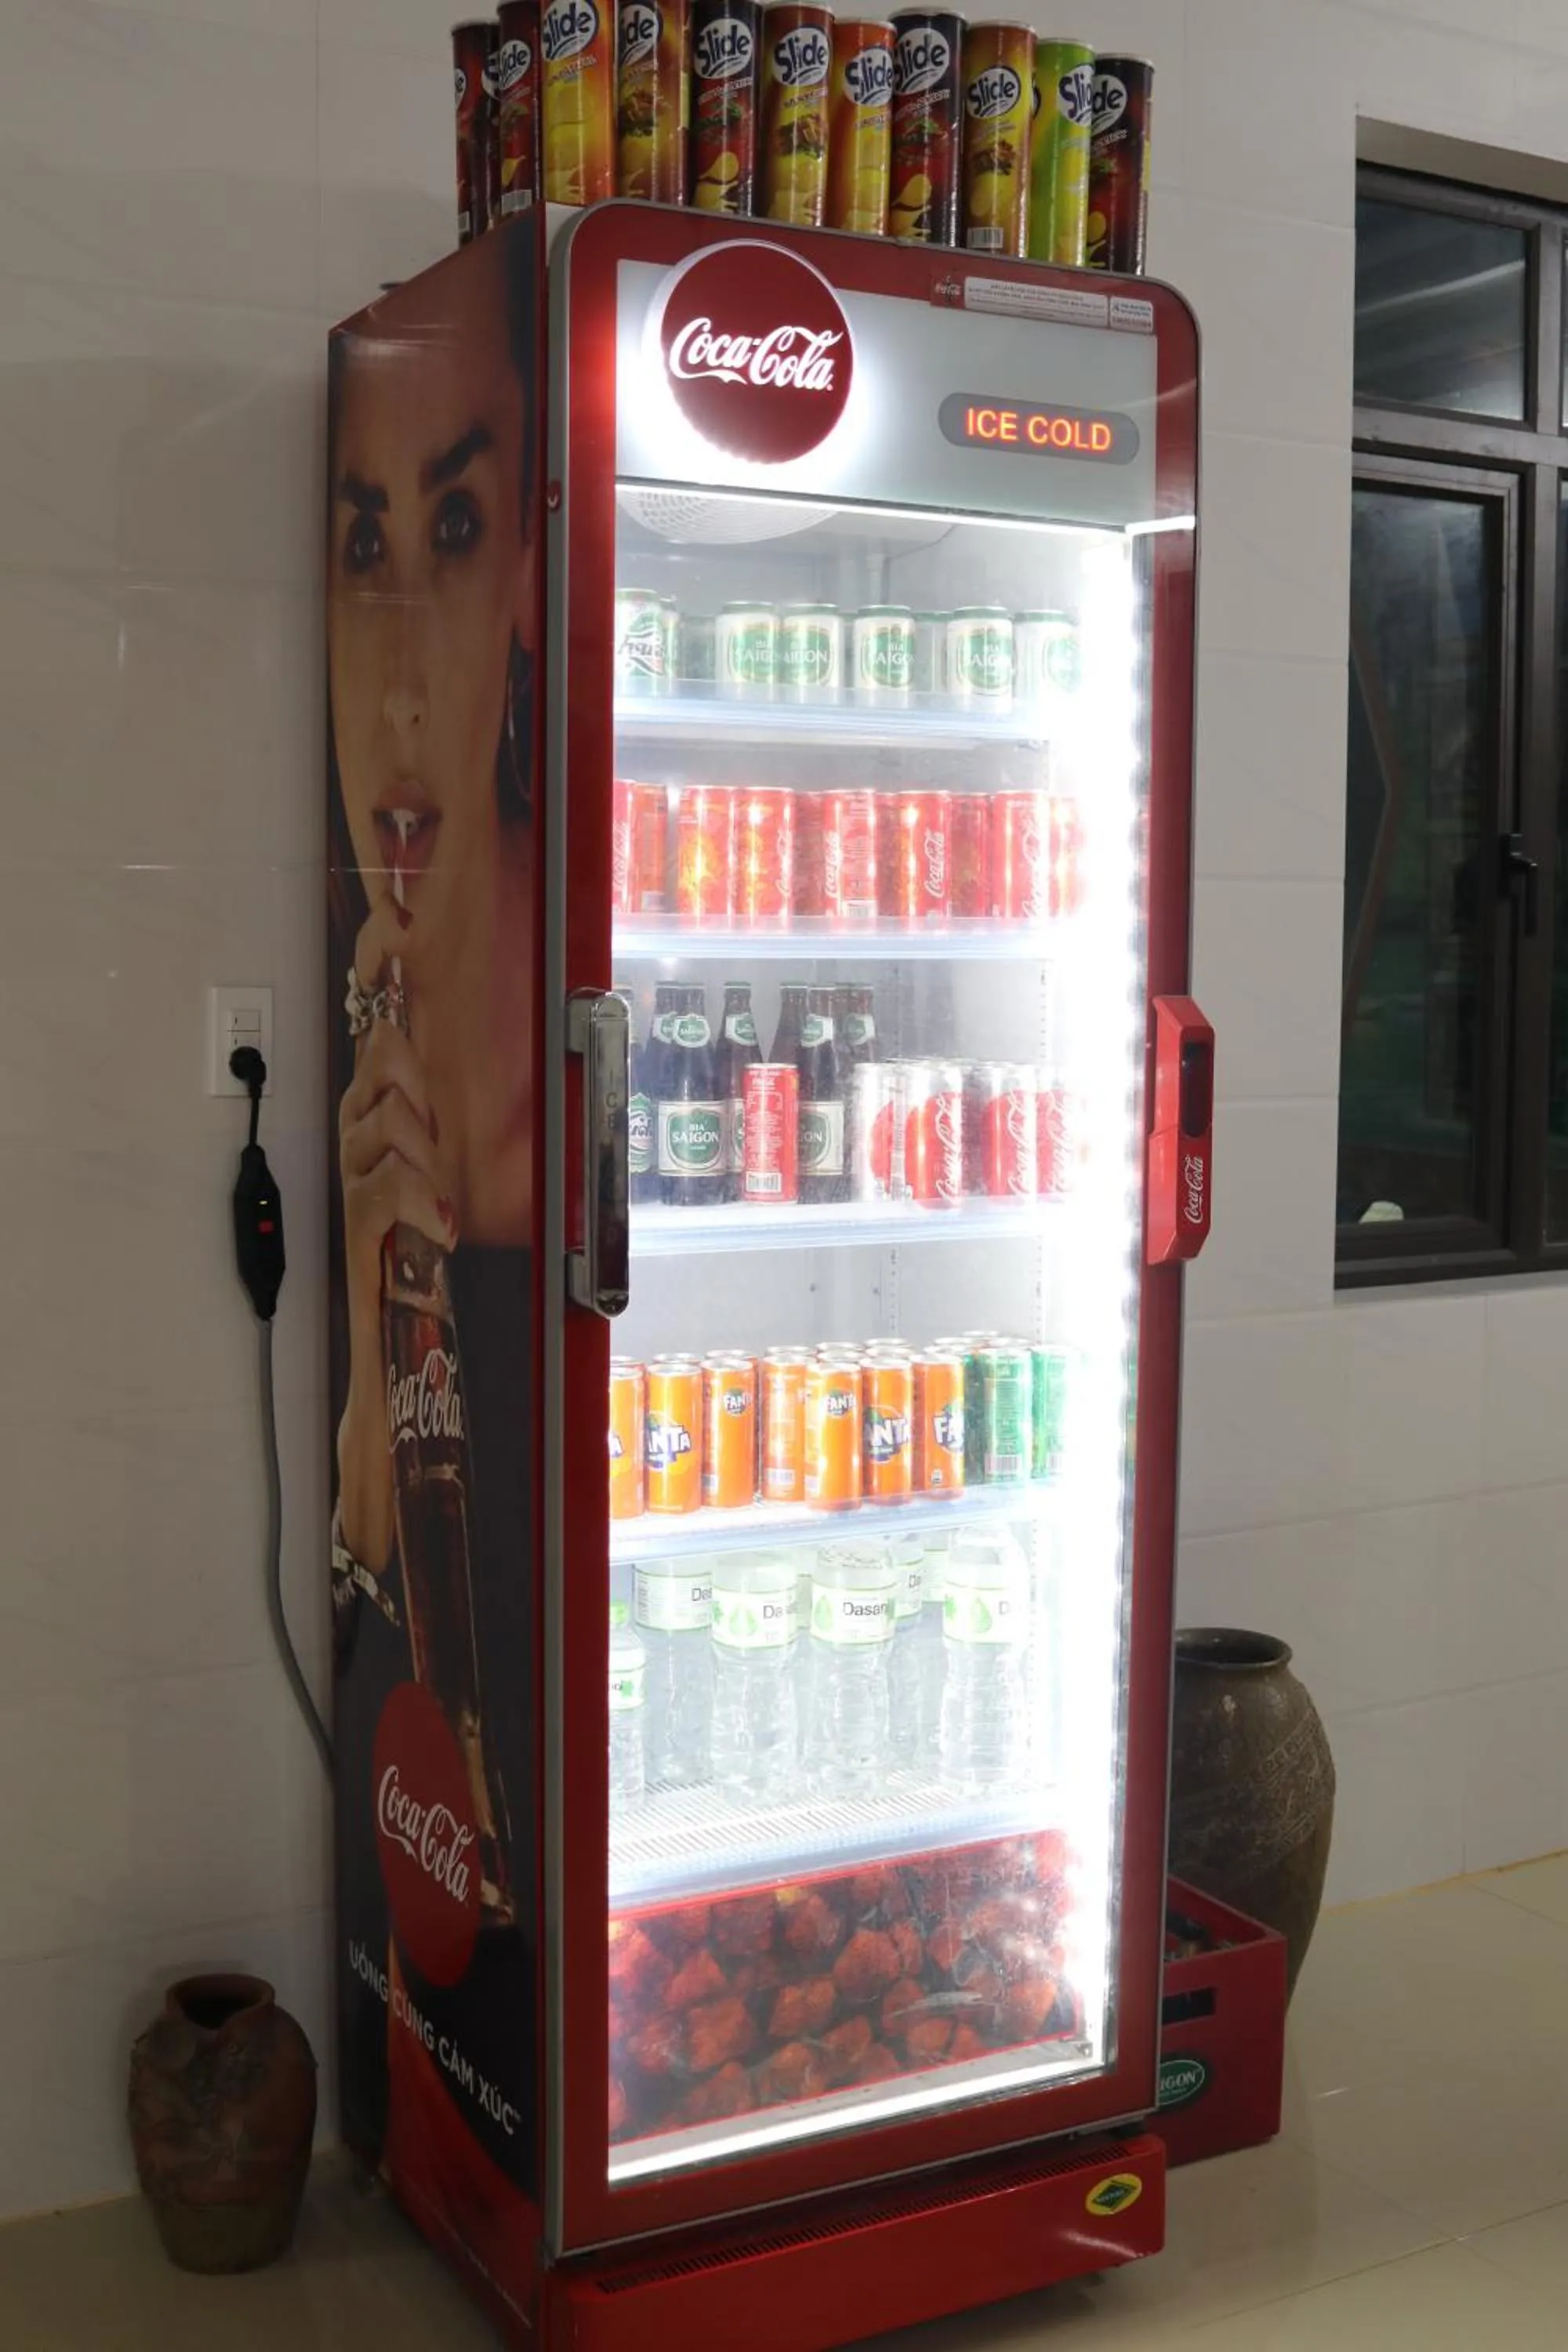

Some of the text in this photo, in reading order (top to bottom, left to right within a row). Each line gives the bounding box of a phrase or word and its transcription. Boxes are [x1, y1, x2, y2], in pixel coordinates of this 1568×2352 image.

[697, 25, 750, 75] Slide
[775, 34, 826, 85] Slide
[967, 73, 1016, 115] Slide
[670, 317, 844, 390] Coca-Cola
[967, 407, 1111, 452] ICE COLD
[672, 1131, 719, 1143] SAIGON
[1185, 1154, 1204, 1224] Coca-Cola
[378, 1764, 475, 1908] Coca-Cola
